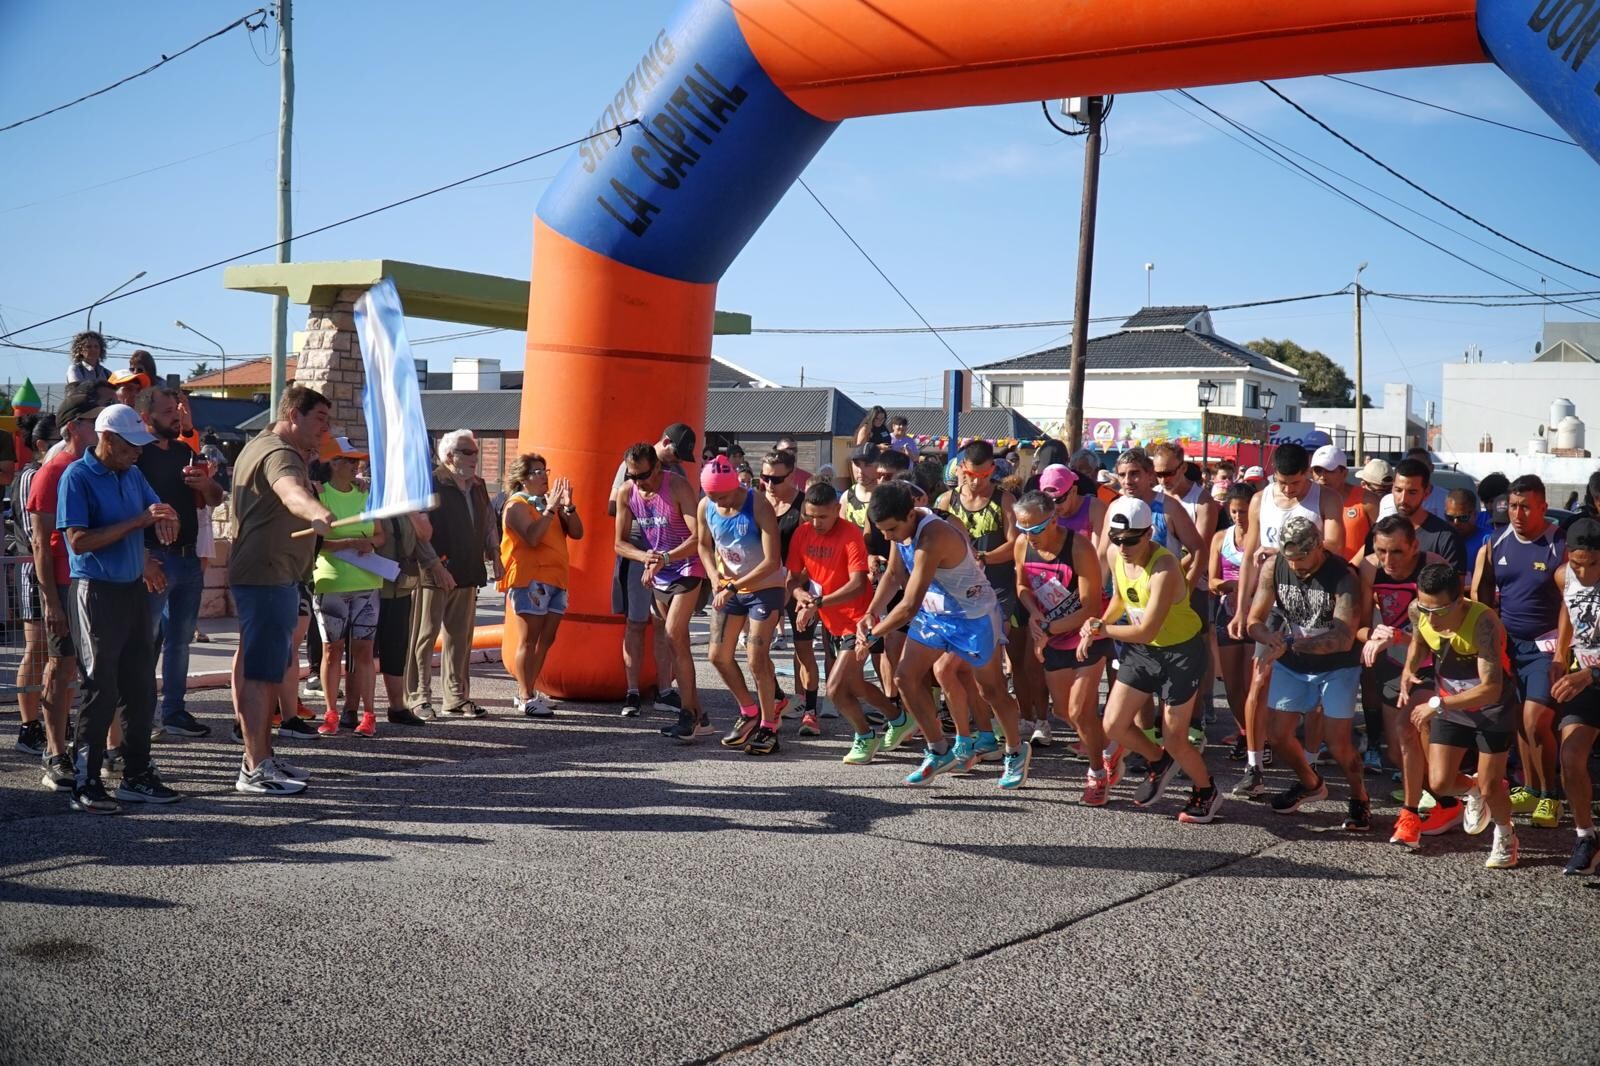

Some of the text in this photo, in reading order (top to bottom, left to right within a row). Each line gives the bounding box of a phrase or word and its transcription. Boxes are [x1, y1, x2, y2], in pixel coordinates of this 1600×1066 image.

[577, 28, 676, 174] SHOPPING
[596, 62, 749, 238] LA CAPITAL
[135, 783, 154, 795] FILA
